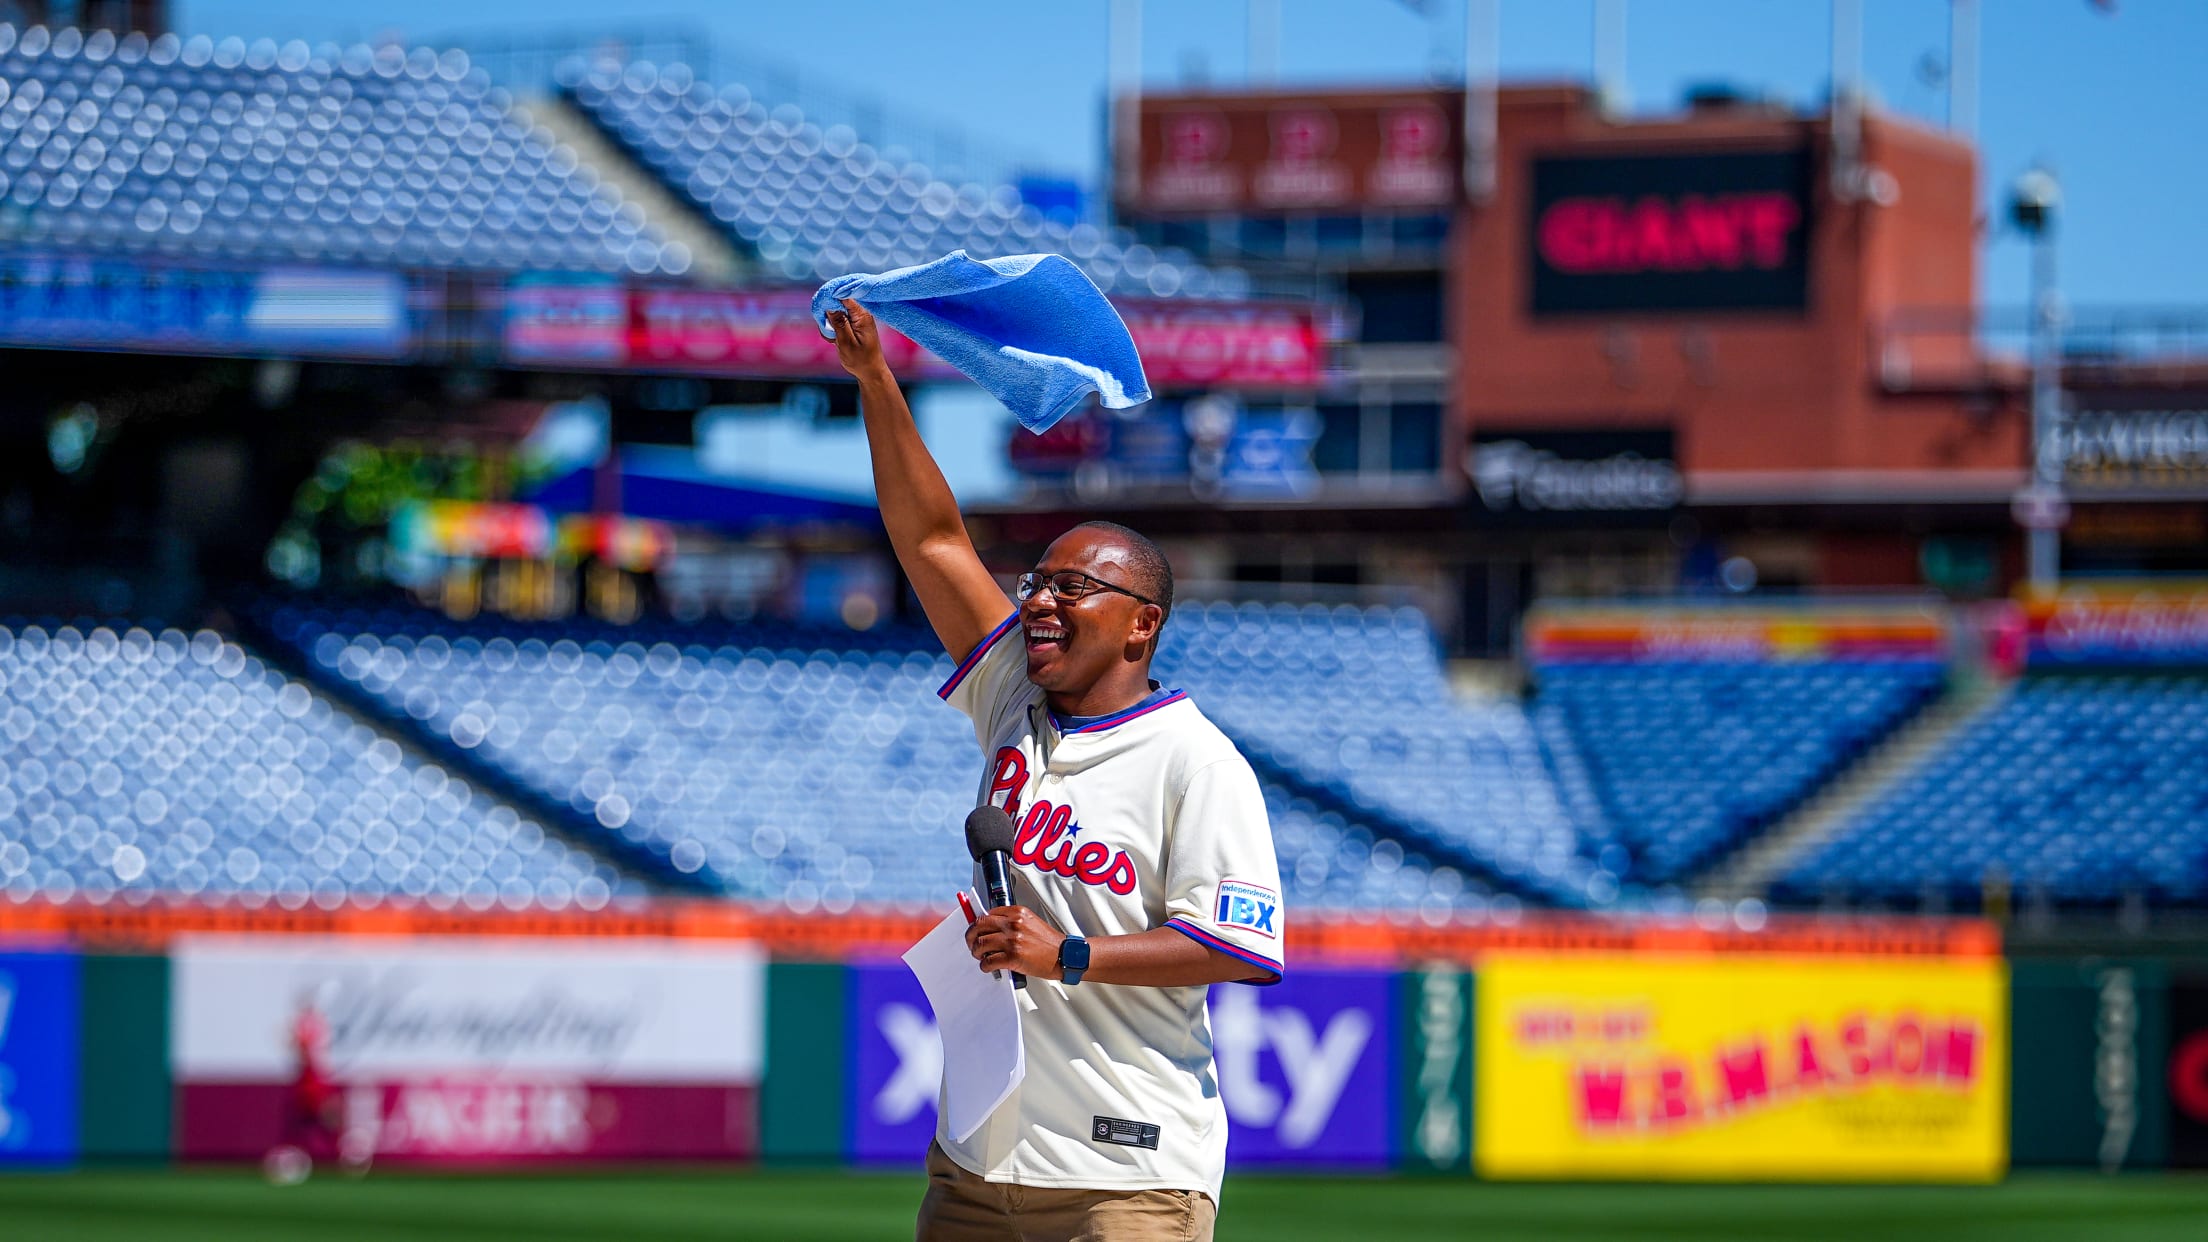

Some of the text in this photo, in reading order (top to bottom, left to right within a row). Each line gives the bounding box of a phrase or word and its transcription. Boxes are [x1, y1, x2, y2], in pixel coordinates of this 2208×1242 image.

[1544, 196, 1795, 268] GIANT
[640, 298, 848, 362] TOYO
[1126, 306, 1316, 378] YOTA
[989, 746, 1136, 895] Phllies
[1218, 895, 1275, 933] IBX
